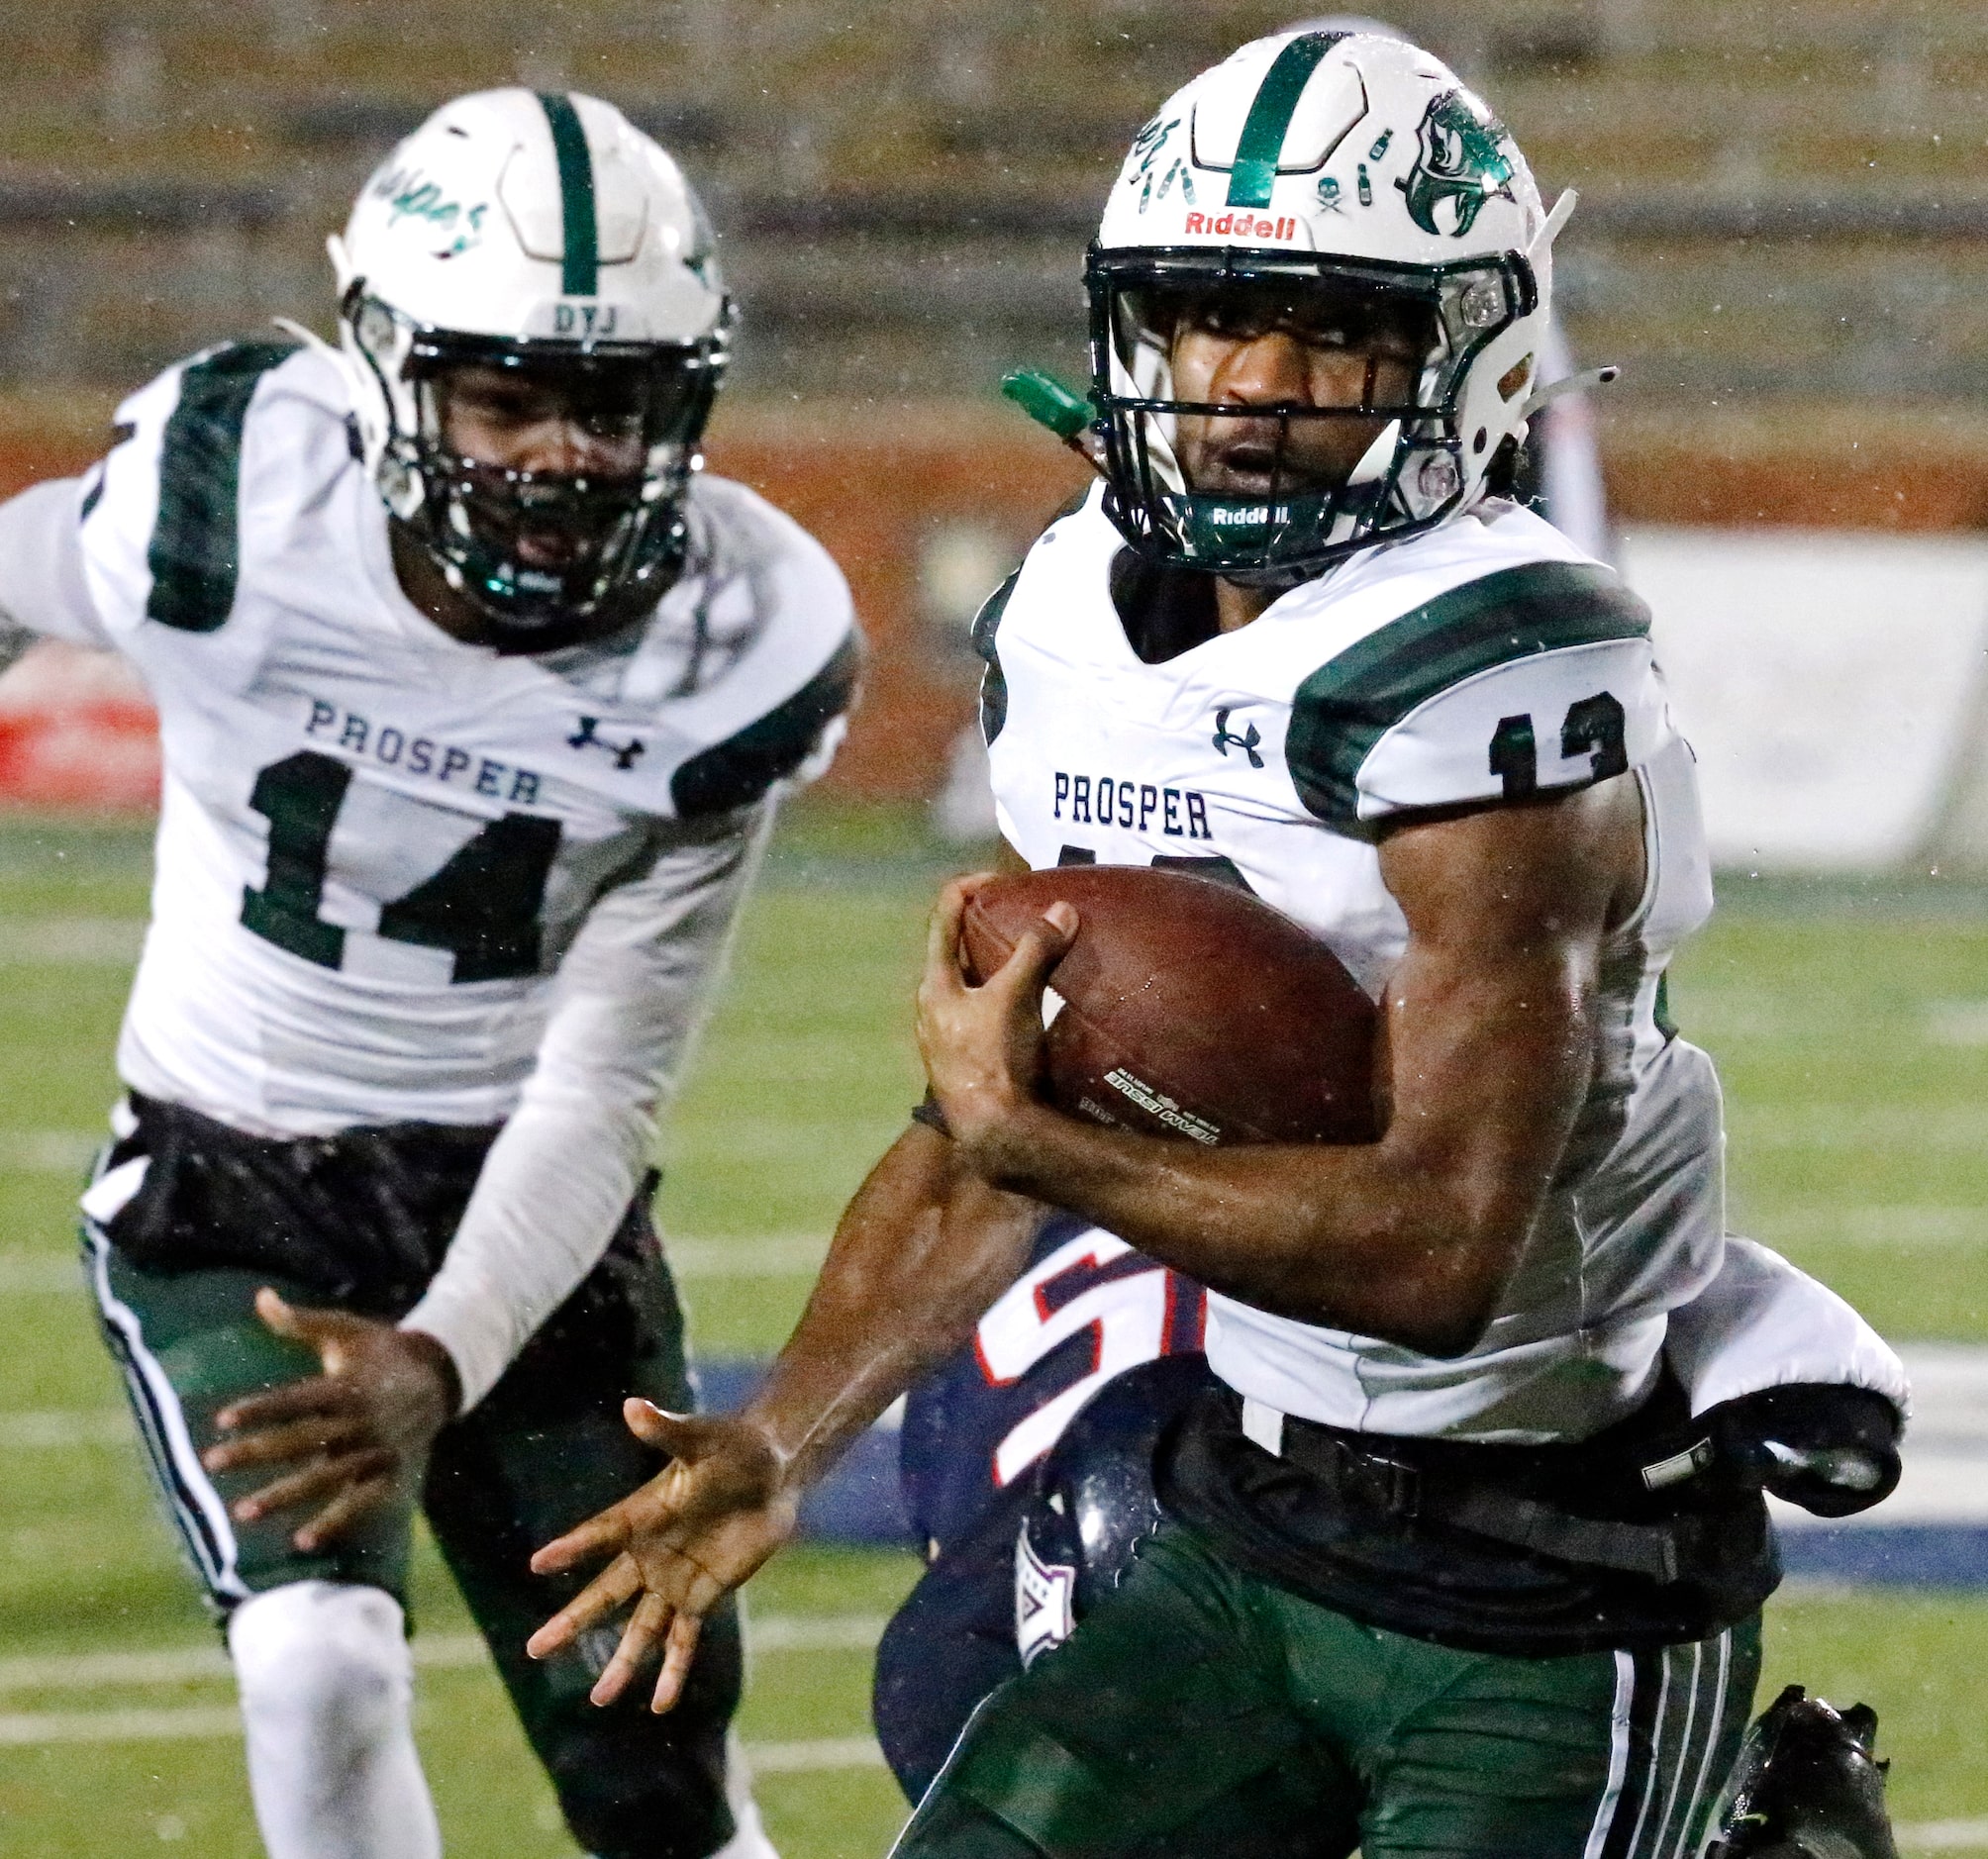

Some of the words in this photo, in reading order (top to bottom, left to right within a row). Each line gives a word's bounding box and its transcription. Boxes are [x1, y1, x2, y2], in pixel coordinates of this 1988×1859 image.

[1185, 212, 1296, 242] Riddell
[305, 698, 541, 805] PROSPER
[1053, 771, 1213, 838] PROSPER
[239, 748, 562, 985] 14
[1103, 1070, 1163, 1115] ISSUE
[1158, 1110, 1221, 1146] TEAM
